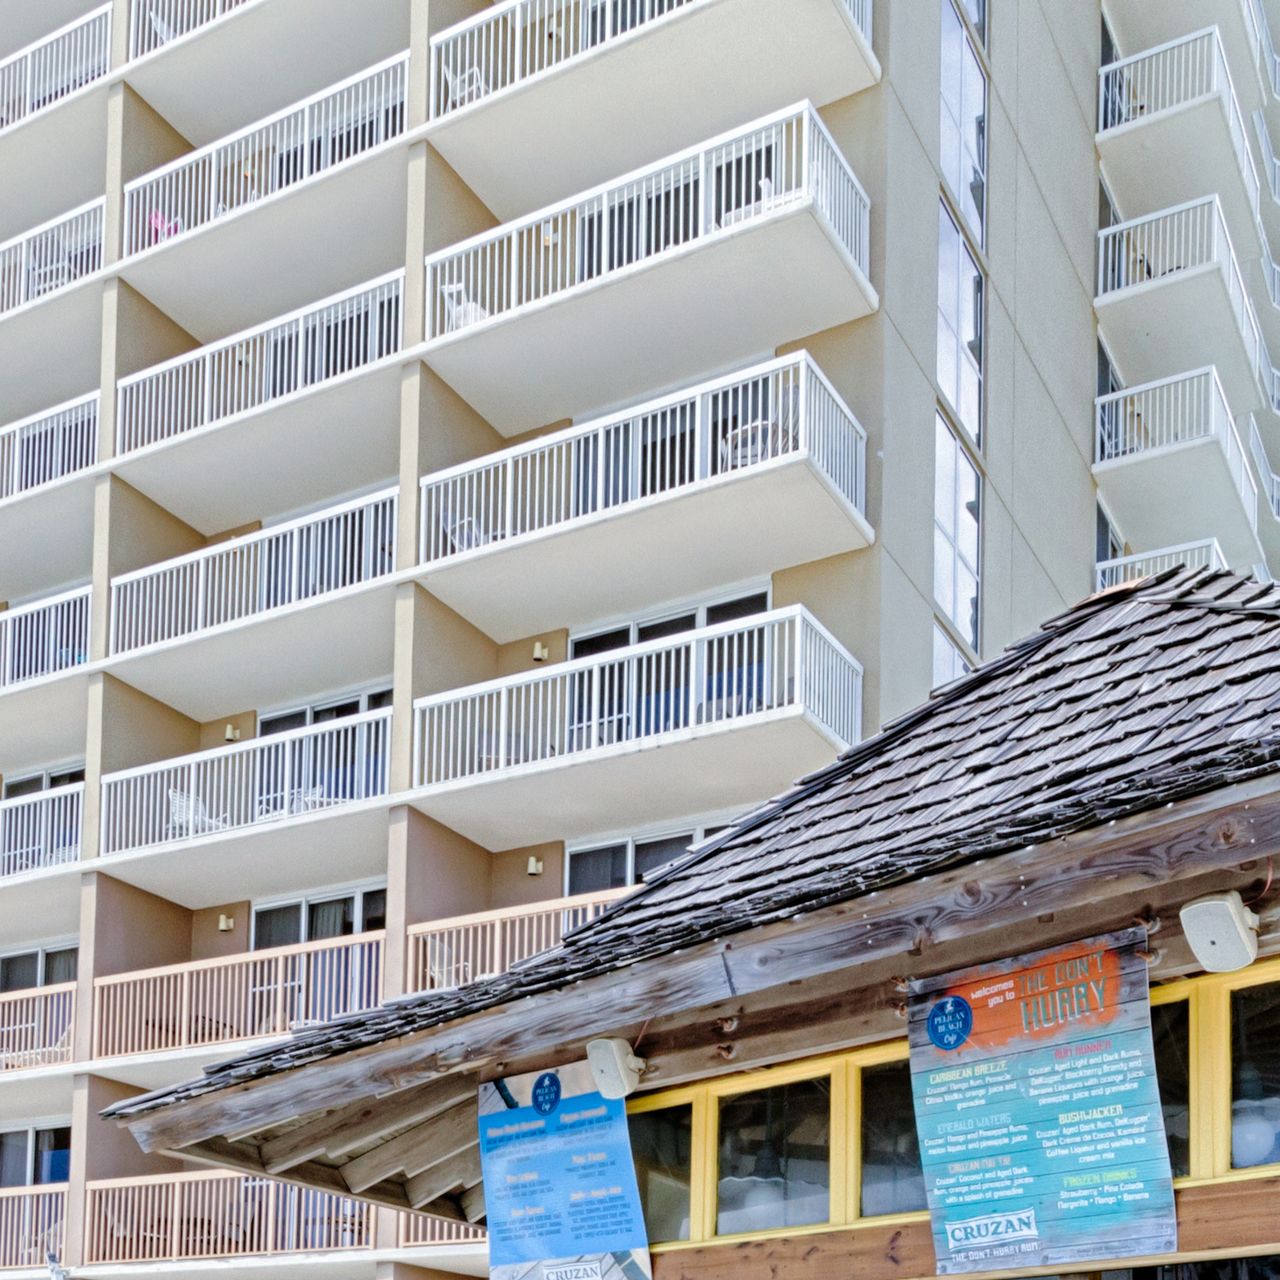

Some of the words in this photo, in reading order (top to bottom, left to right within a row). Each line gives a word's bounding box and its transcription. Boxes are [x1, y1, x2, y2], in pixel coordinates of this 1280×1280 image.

[1017, 968, 1048, 997] THE
[1055, 951, 1105, 985] DON'T
[971, 979, 1014, 1000] welcomes
[987, 995, 1004, 1008] you
[1005, 991, 1015, 1001] to
[1021, 976, 1107, 1034] HURRY
[1058, 1103, 1124, 1125] BUSHWACKER
[951, 1216, 1032, 1242] CRUZAN
